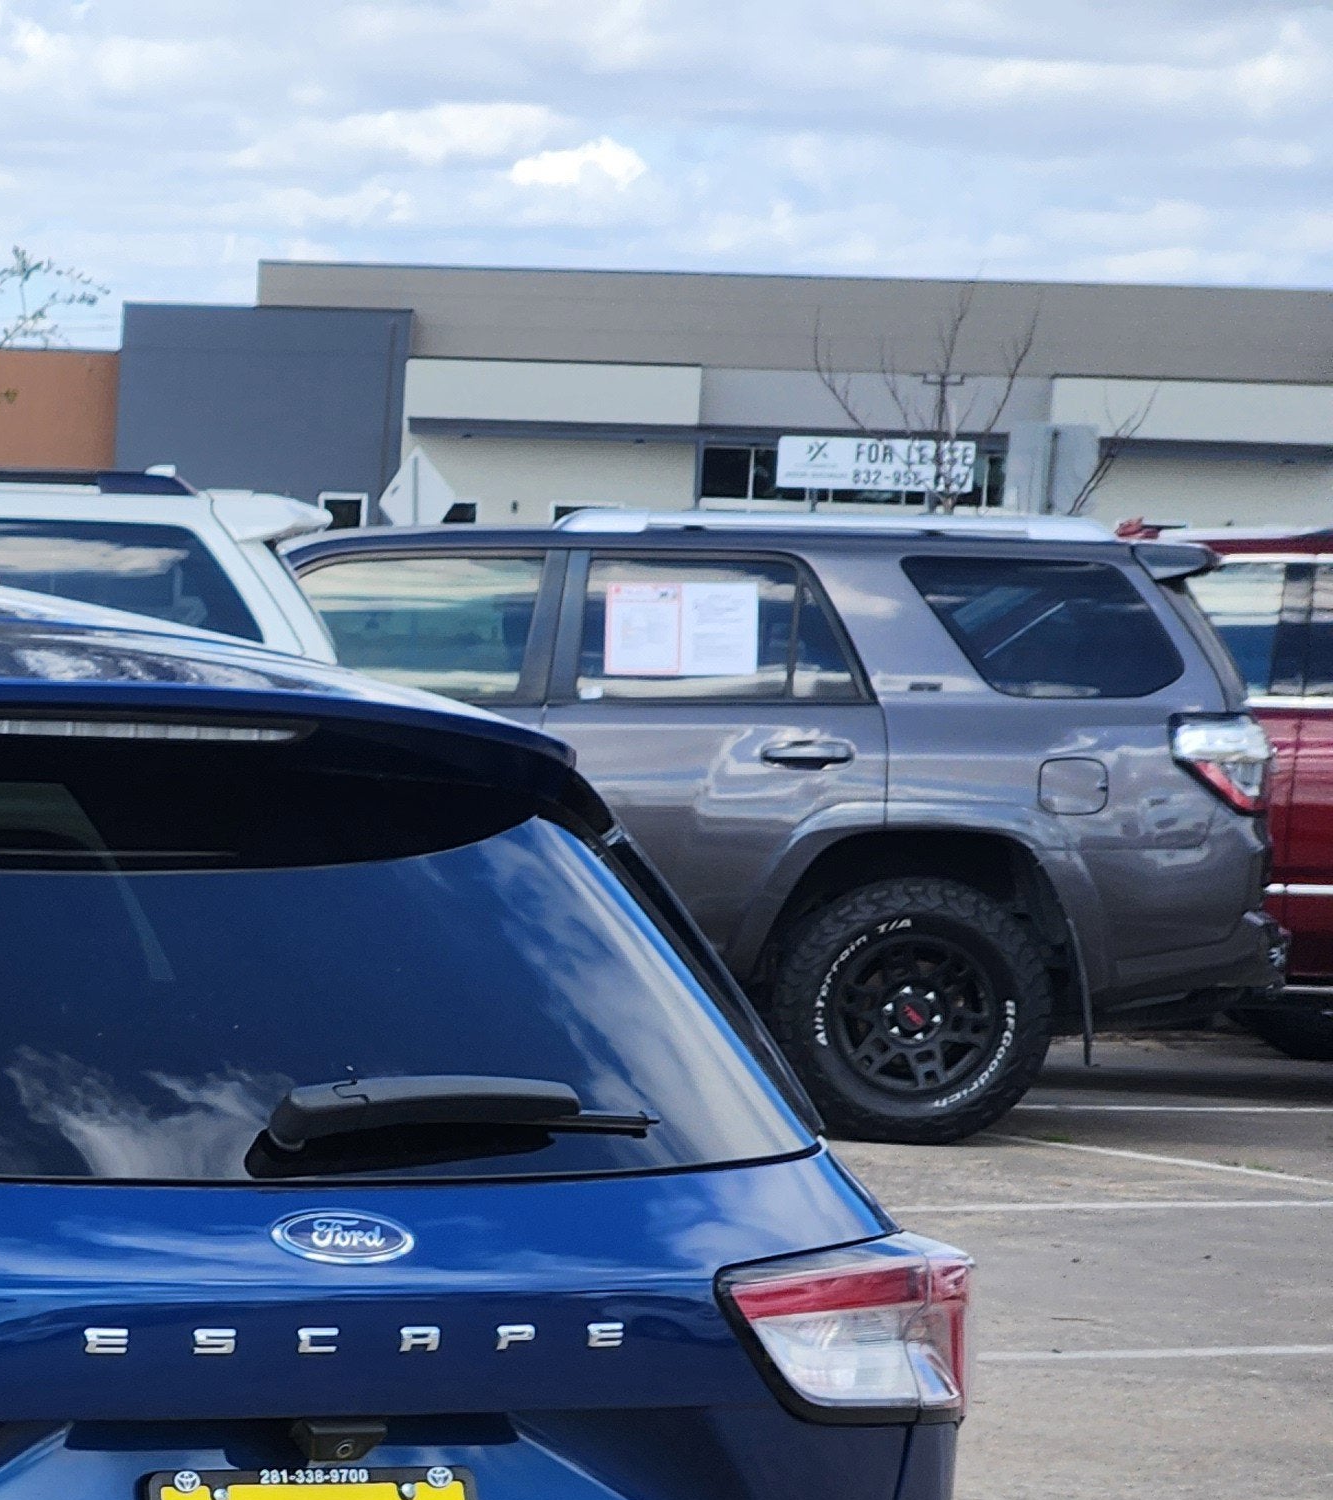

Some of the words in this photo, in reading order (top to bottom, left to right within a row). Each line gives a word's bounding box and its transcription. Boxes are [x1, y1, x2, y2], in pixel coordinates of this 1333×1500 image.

[855, 442, 894, 464] FOR
[876, 918, 912, 934] T/A
[311, 1218, 386, 1248] Ford
[84, 1321, 626, 1355] ESCAPE
[259, 1468, 369, 1485] 281-338-9700
